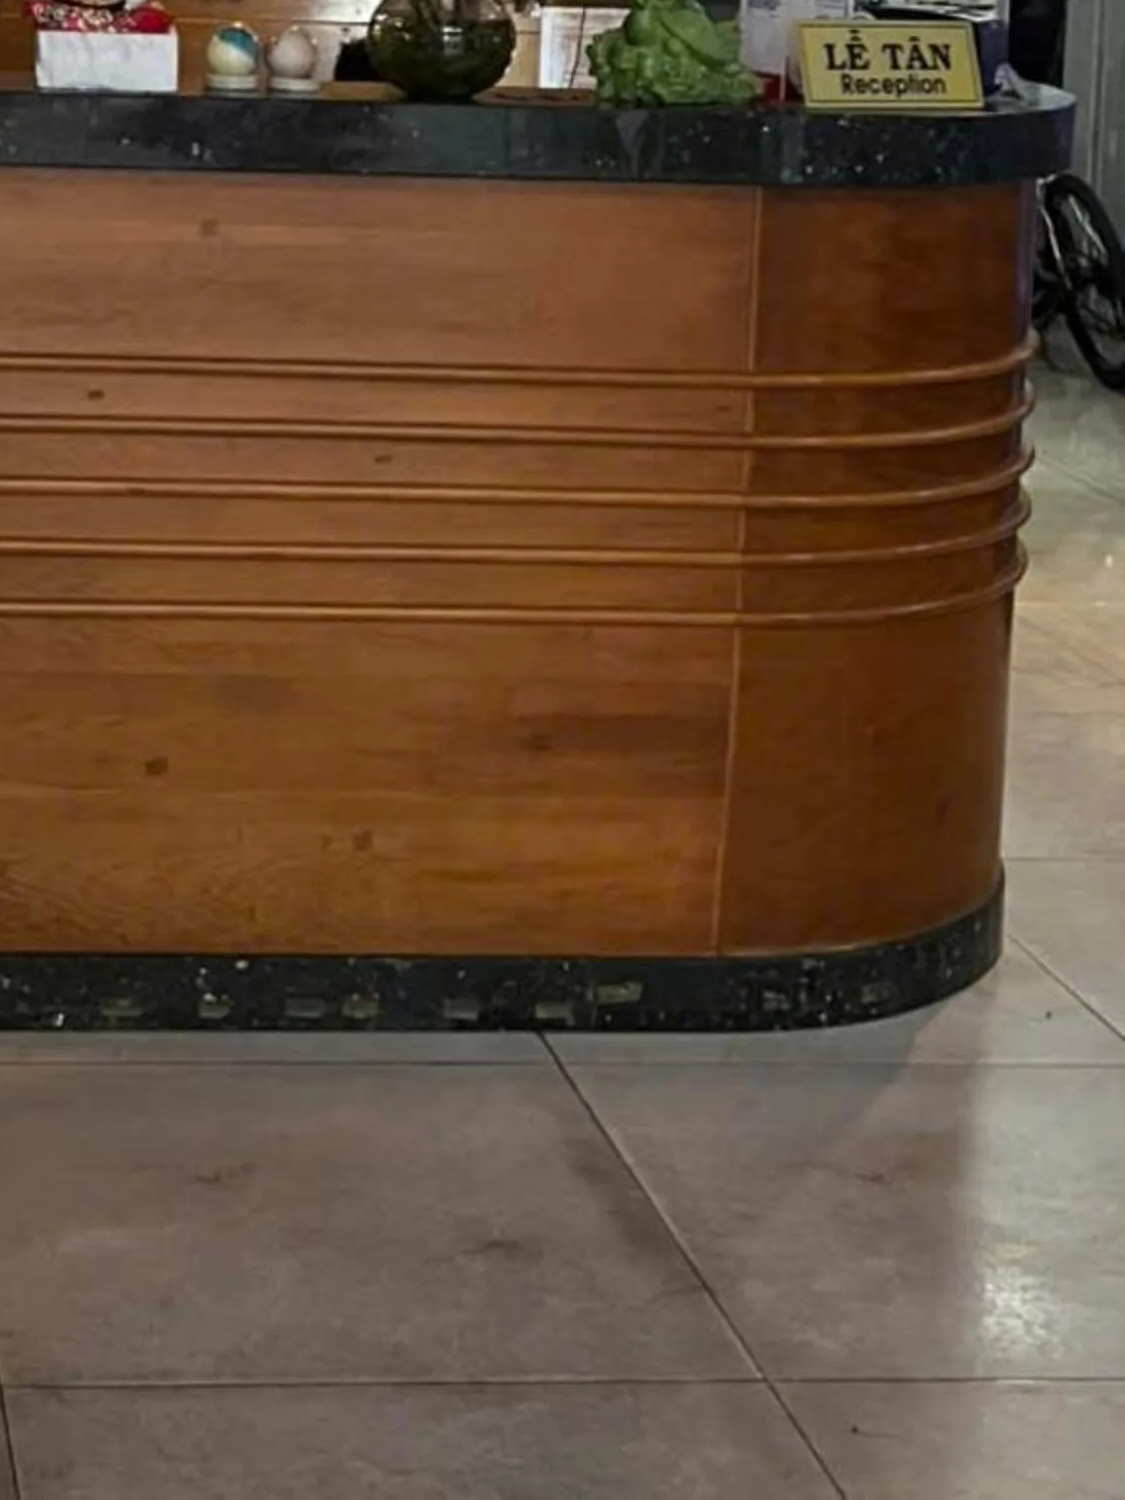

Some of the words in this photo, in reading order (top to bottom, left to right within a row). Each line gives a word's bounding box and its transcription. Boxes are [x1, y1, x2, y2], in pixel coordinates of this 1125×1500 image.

[824, 29, 870, 71] LỄ
[882, 36, 951, 71] TÂN
[841, 73, 947, 98] Reception
